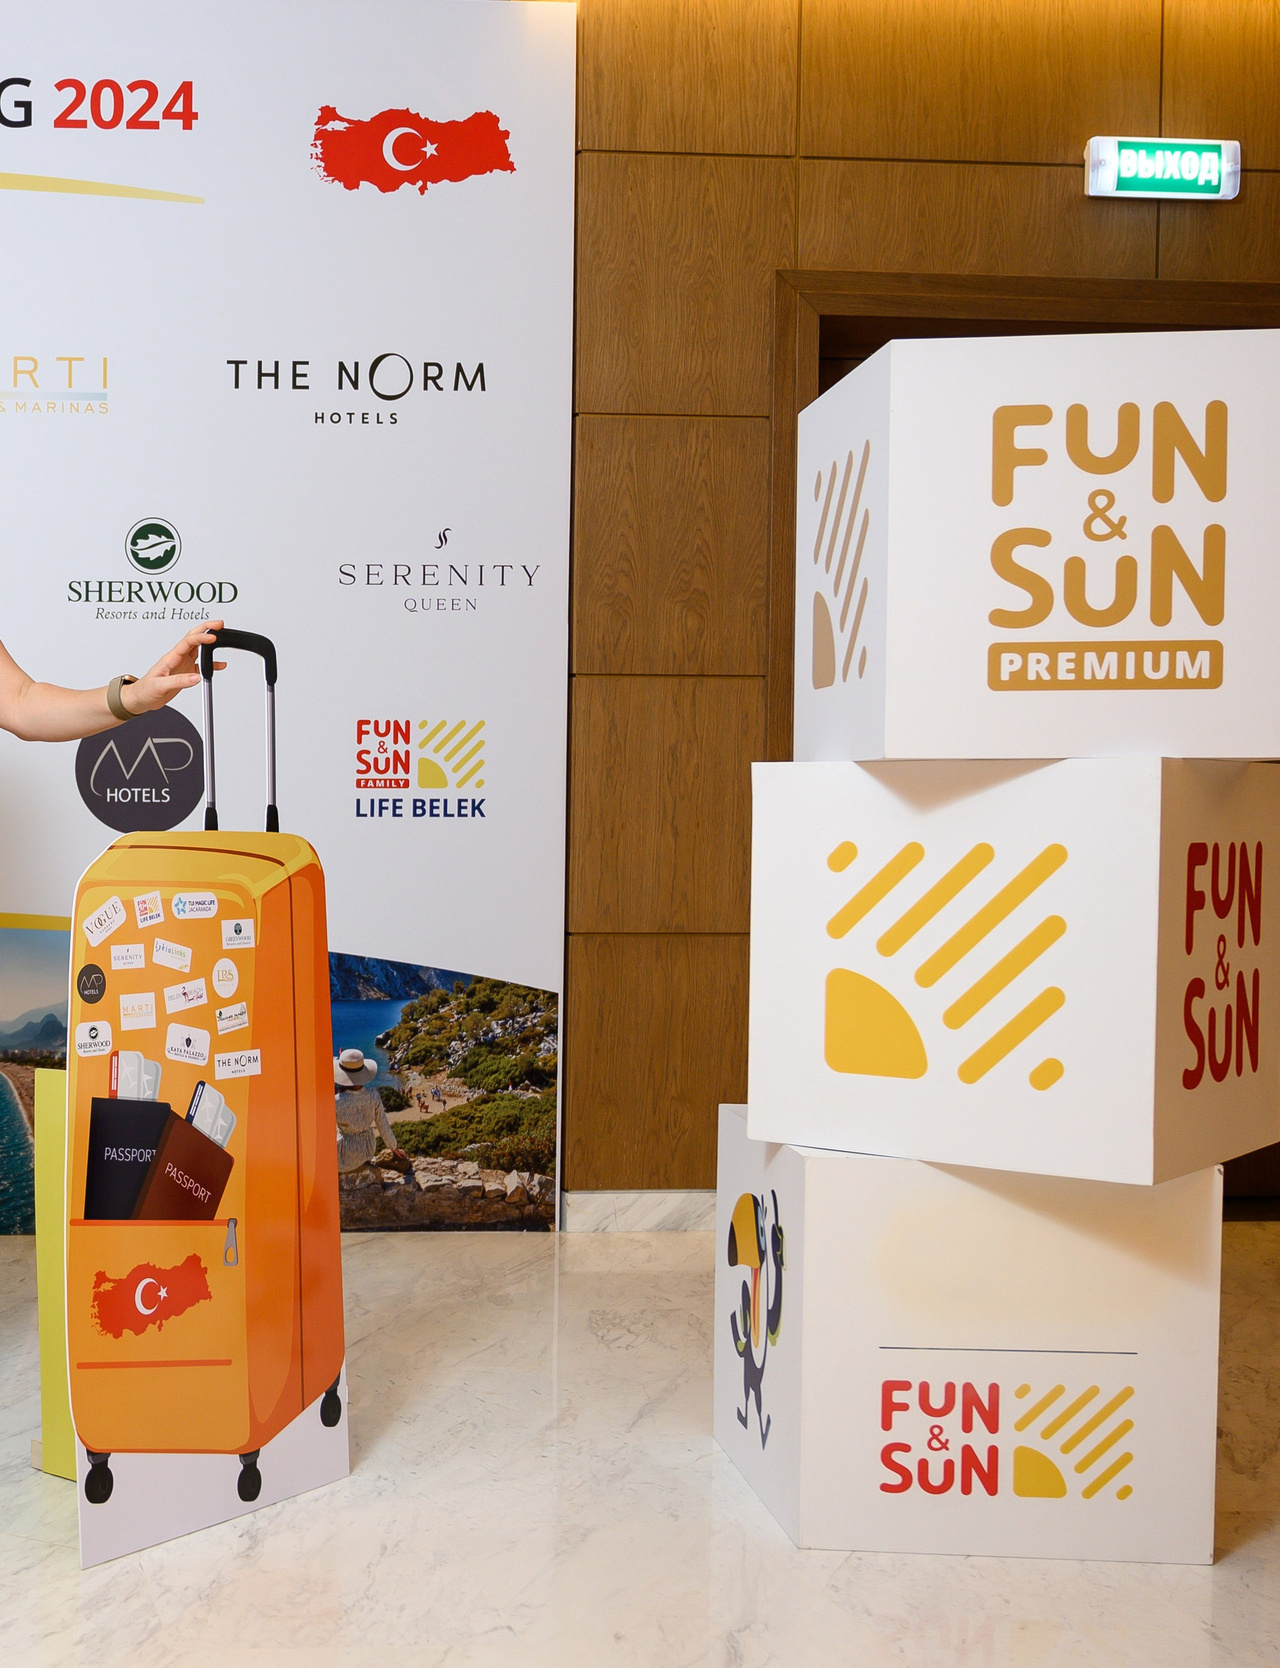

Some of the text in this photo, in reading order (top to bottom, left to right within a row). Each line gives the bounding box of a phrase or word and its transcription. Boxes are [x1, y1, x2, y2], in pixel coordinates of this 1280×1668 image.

[53, 78, 199, 132] 2024
[1120, 149, 1219, 186] ВЫХОД
[227, 352, 487, 401] THE NORM
[14, 401, 109, 414] MARINAS
[314, 411, 399, 425] HOTELS
[991, 400, 1228, 507] FUN
[1083, 489, 1127, 542] &
[338, 563, 541, 586] SERENITY
[988, 524, 1226, 629] SUN
[67, 580, 238, 604] SHERWOOD
[404, 598, 477, 613] QUEEN
[95, 607, 210, 621] Resorts and Hotels
[1000, 650, 1211, 681] PREMIUM
[356, 719, 411, 745] FUN
[377, 740, 388, 754] &
[355, 749, 410, 775] SUN
[106, 787, 170, 803] HOTELS
[360, 779, 405, 787] FAMILY
[355, 798, 486, 818] LIFE BELEK
[1185, 841, 1263, 956] FUN
[85, 901, 122, 934] VOGUE
[1214, 934, 1230, 990] &
[122, 1003, 153, 1014] MARTI
[1182, 968, 1260, 1090] SUN
[217, 1055, 259, 1067] THE NORM
[104, 1147, 157, 1162] PASSPORT
[164, 1162, 212, 1203] PASSPORT
[881, 1380, 1000, 1434] FUN
[927, 1424, 950, 1452] &
[879, 1442, 999, 1496] SUN
